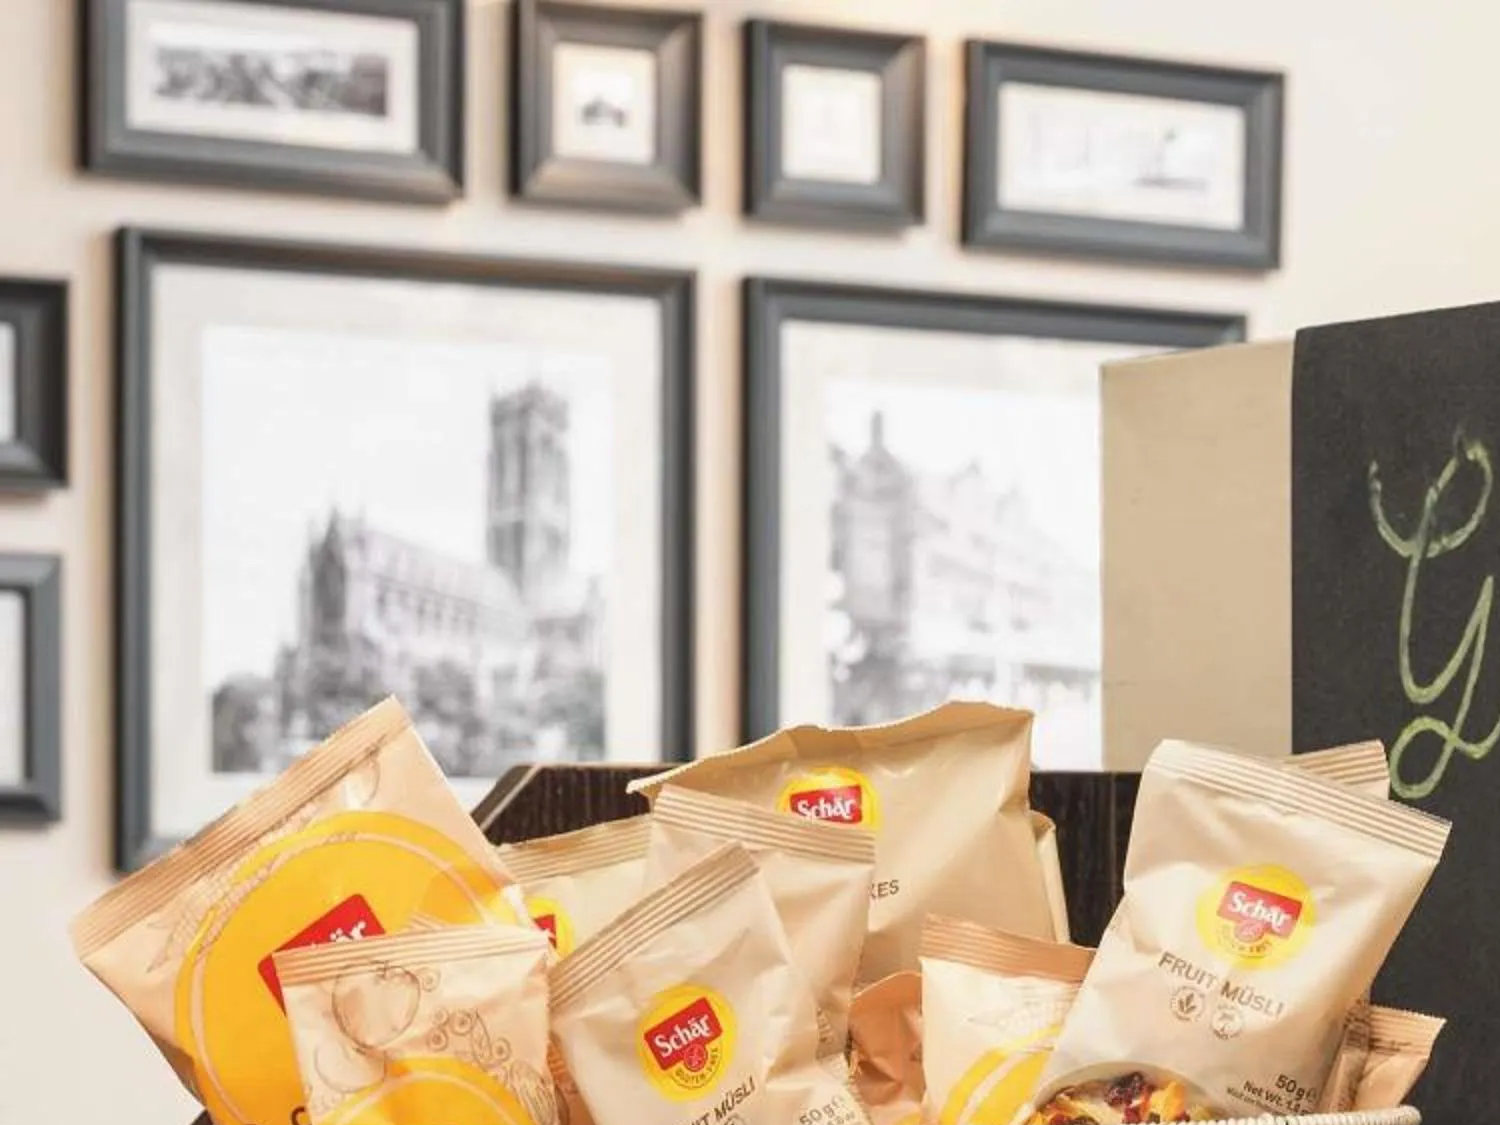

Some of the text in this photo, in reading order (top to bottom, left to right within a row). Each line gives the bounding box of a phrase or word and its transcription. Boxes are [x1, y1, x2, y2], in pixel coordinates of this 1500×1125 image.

[1158, 951, 1217, 989] FRUIT
[1220, 980, 1284, 1017] MÜSLI
[654, 1012, 711, 1057] Schär
[714, 1076, 756, 1122] MÜSLI
[1243, 1080, 1263, 1097] Net
